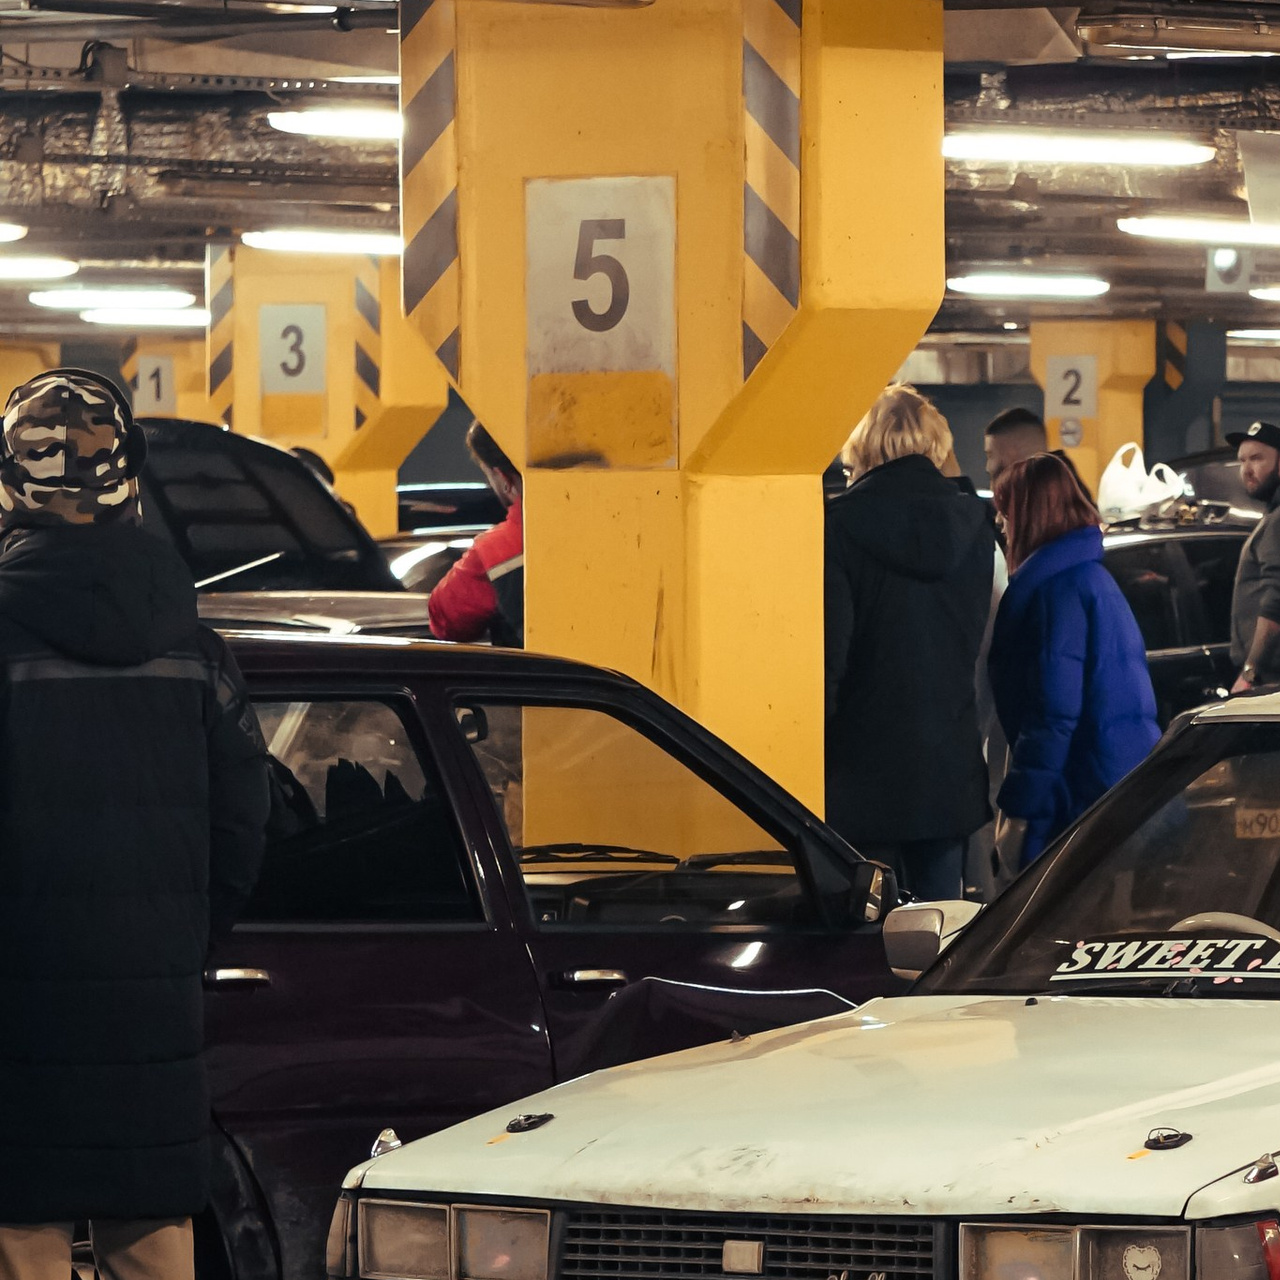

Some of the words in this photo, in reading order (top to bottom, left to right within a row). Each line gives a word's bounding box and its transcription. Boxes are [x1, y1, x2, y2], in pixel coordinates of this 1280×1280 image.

[571, 218, 630, 333] 5
[279, 324, 307, 378] 3
[149, 367, 162, 402] 1
[1061, 368, 1083, 406] 2
[1056, 939, 1258, 974] SWEET
